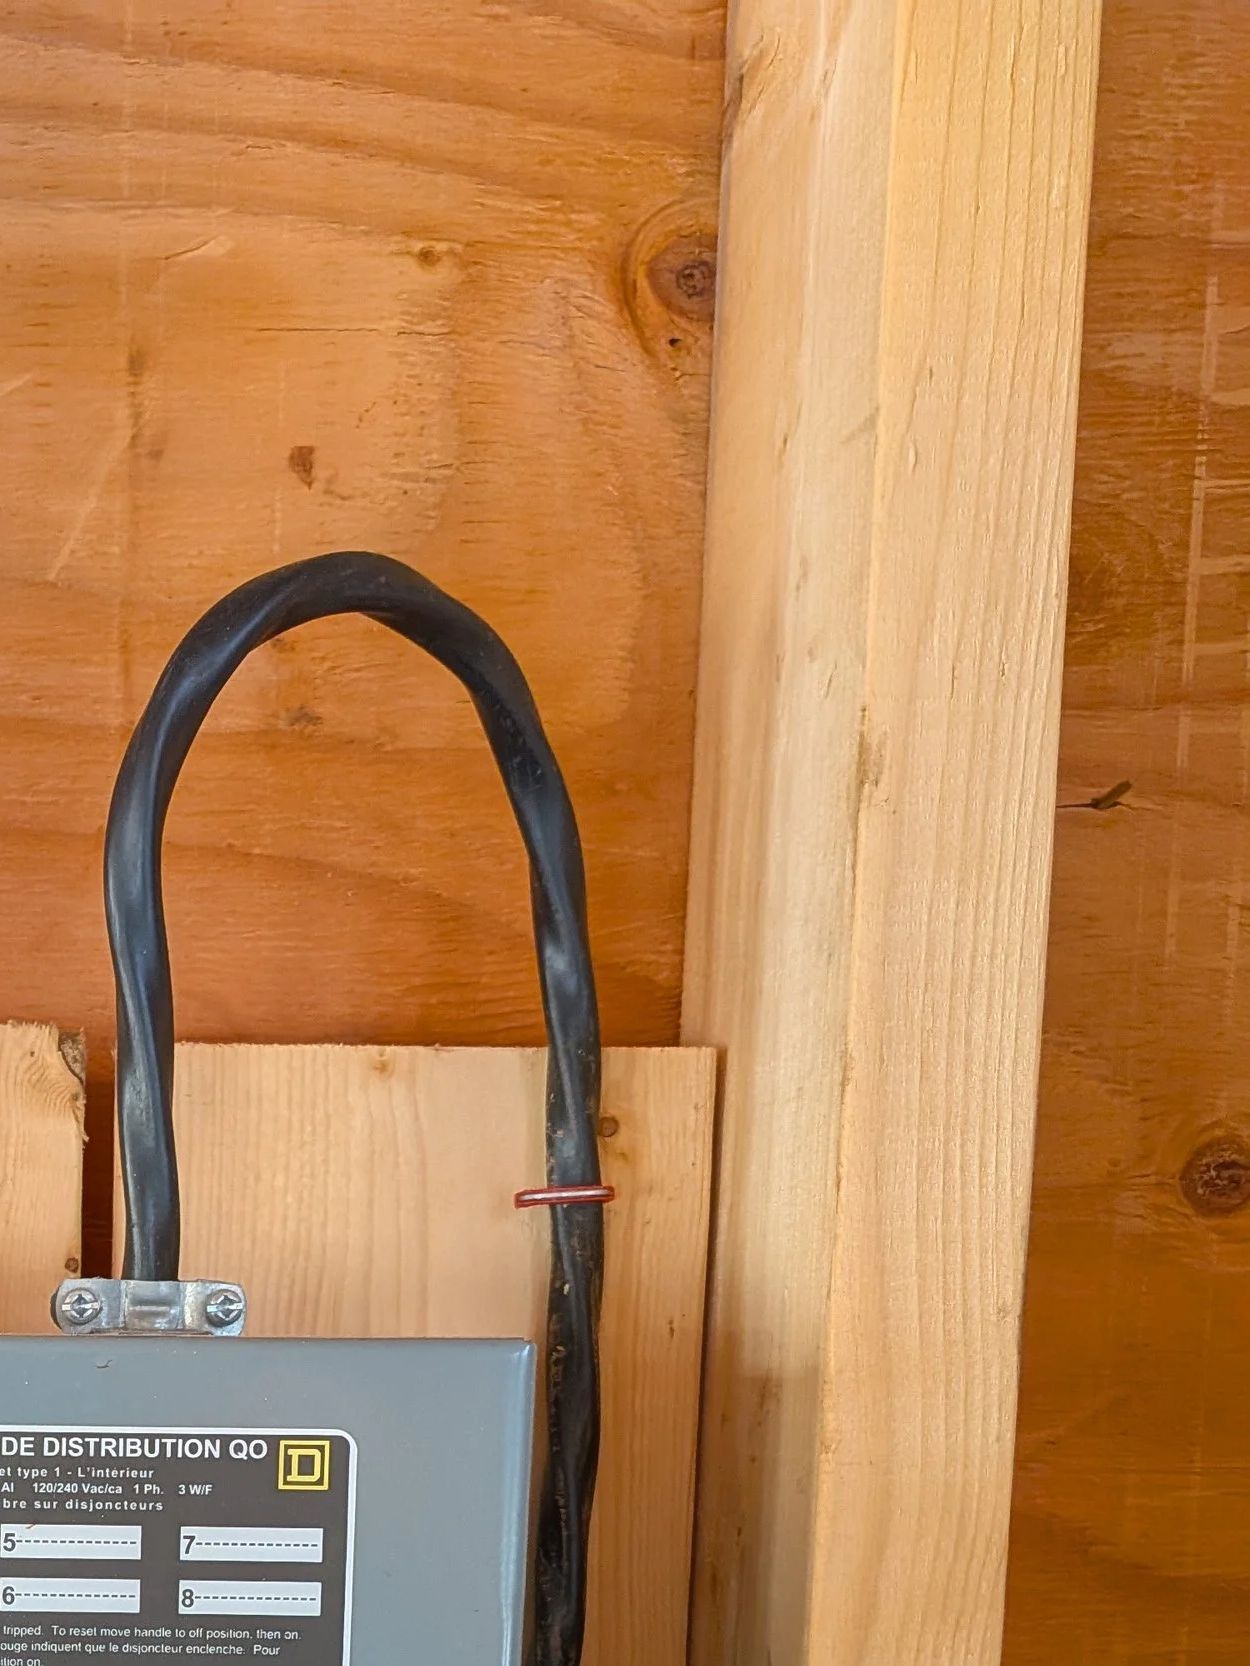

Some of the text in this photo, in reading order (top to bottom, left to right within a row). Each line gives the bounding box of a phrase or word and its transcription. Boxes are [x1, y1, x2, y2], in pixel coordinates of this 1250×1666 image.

[2, 1437, 34, 1456] DE
[43, 1437, 220, 1458] DISTRIBUTION
[229, 1439, 267, 1460] QO
[17, 1467, 47, 1479] type
[53, 1467, 60, 1477] 1
[1, 1482, 13, 1492] Al
[32, 1482, 78, 1493] 120/240
[82, 1483, 122, 1494] Vac/ca
[132, 1484, 139, 1494] 1
[144, 1484, 163, 1494] Ph.
[178, 1484, 185, 1494] 3
[189, 1484, 212, 1495] W/F
[34, 1501, 58, 1509] sur
[65, 1499, 162, 1512] disjoncteurs
[2, 1533, 17, 1551] 5
[183, 1536, 196, 1554] 7
[1, 1586, 16, 1605] 6
[181, 1589, 195, 1608] 8
[51, 1625, 66, 1636] To
[69, 1627, 96, 1636] reset
[100, 1628, 130, 1637] move
[134, 1627, 171, 1637] handle
[175, 1629, 185, 1638] to
[188, 1627, 202, 1638] off
[256, 1629, 280, 1639] then
